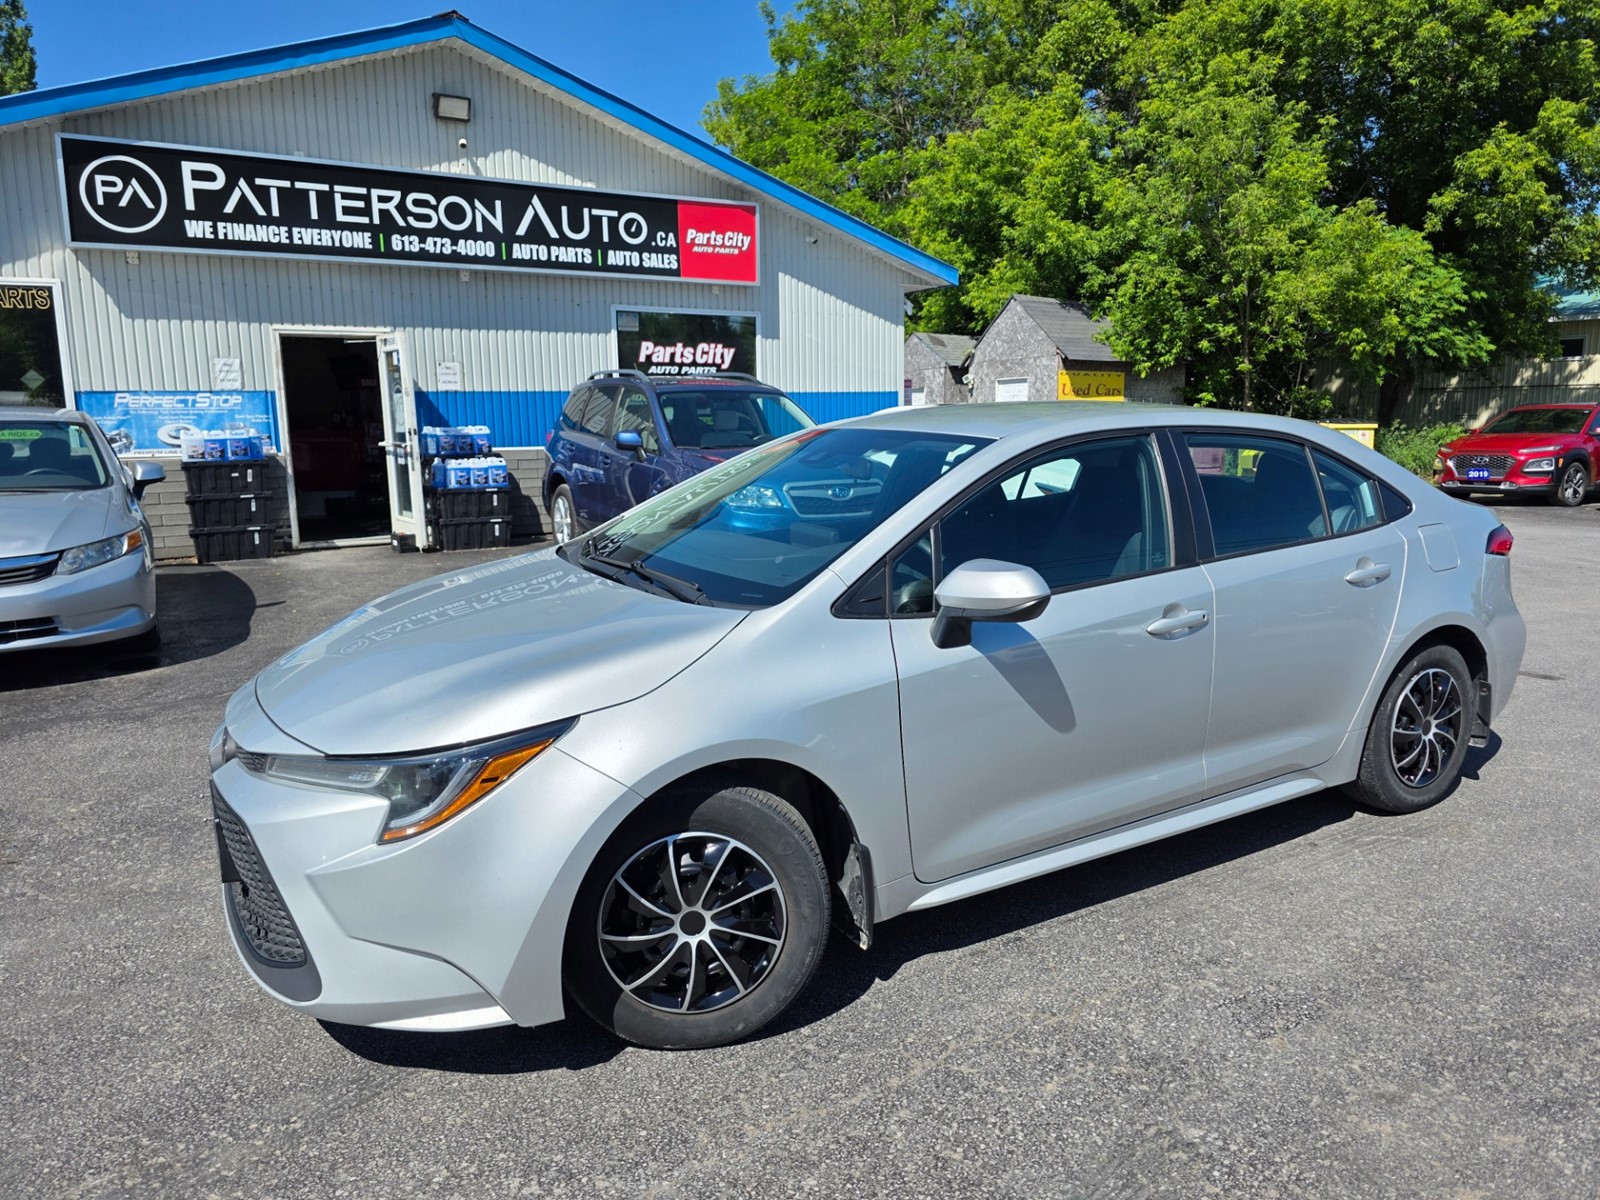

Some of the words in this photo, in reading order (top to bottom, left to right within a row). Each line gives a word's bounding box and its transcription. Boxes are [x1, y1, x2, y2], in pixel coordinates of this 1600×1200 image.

[94, 174, 155, 209] PA
[181, 160, 504, 234] PATTERSON
[184, 219, 214, 239] WE
[216, 221, 290, 244] FINANCE
[292, 227, 373, 249] EVERYONE
[391, 233, 495, 257] 613-473-4000
[512, 243, 549, 260] AUTO
[551, 246, 593, 264] PARTS
[607, 250, 641, 267] AUTO
[642, 253, 678, 270] SALES
[692, 245, 714, 254] AUTO
[714, 247, 740, 255] PARTS
[648, 365, 679, 374] AUTO
[680, 366, 717, 375] PARTS
[1062, 383, 1091, 396] Used
[1095, 383, 1122, 396] Cars
[1468, 470, 1489, 478] 2019
